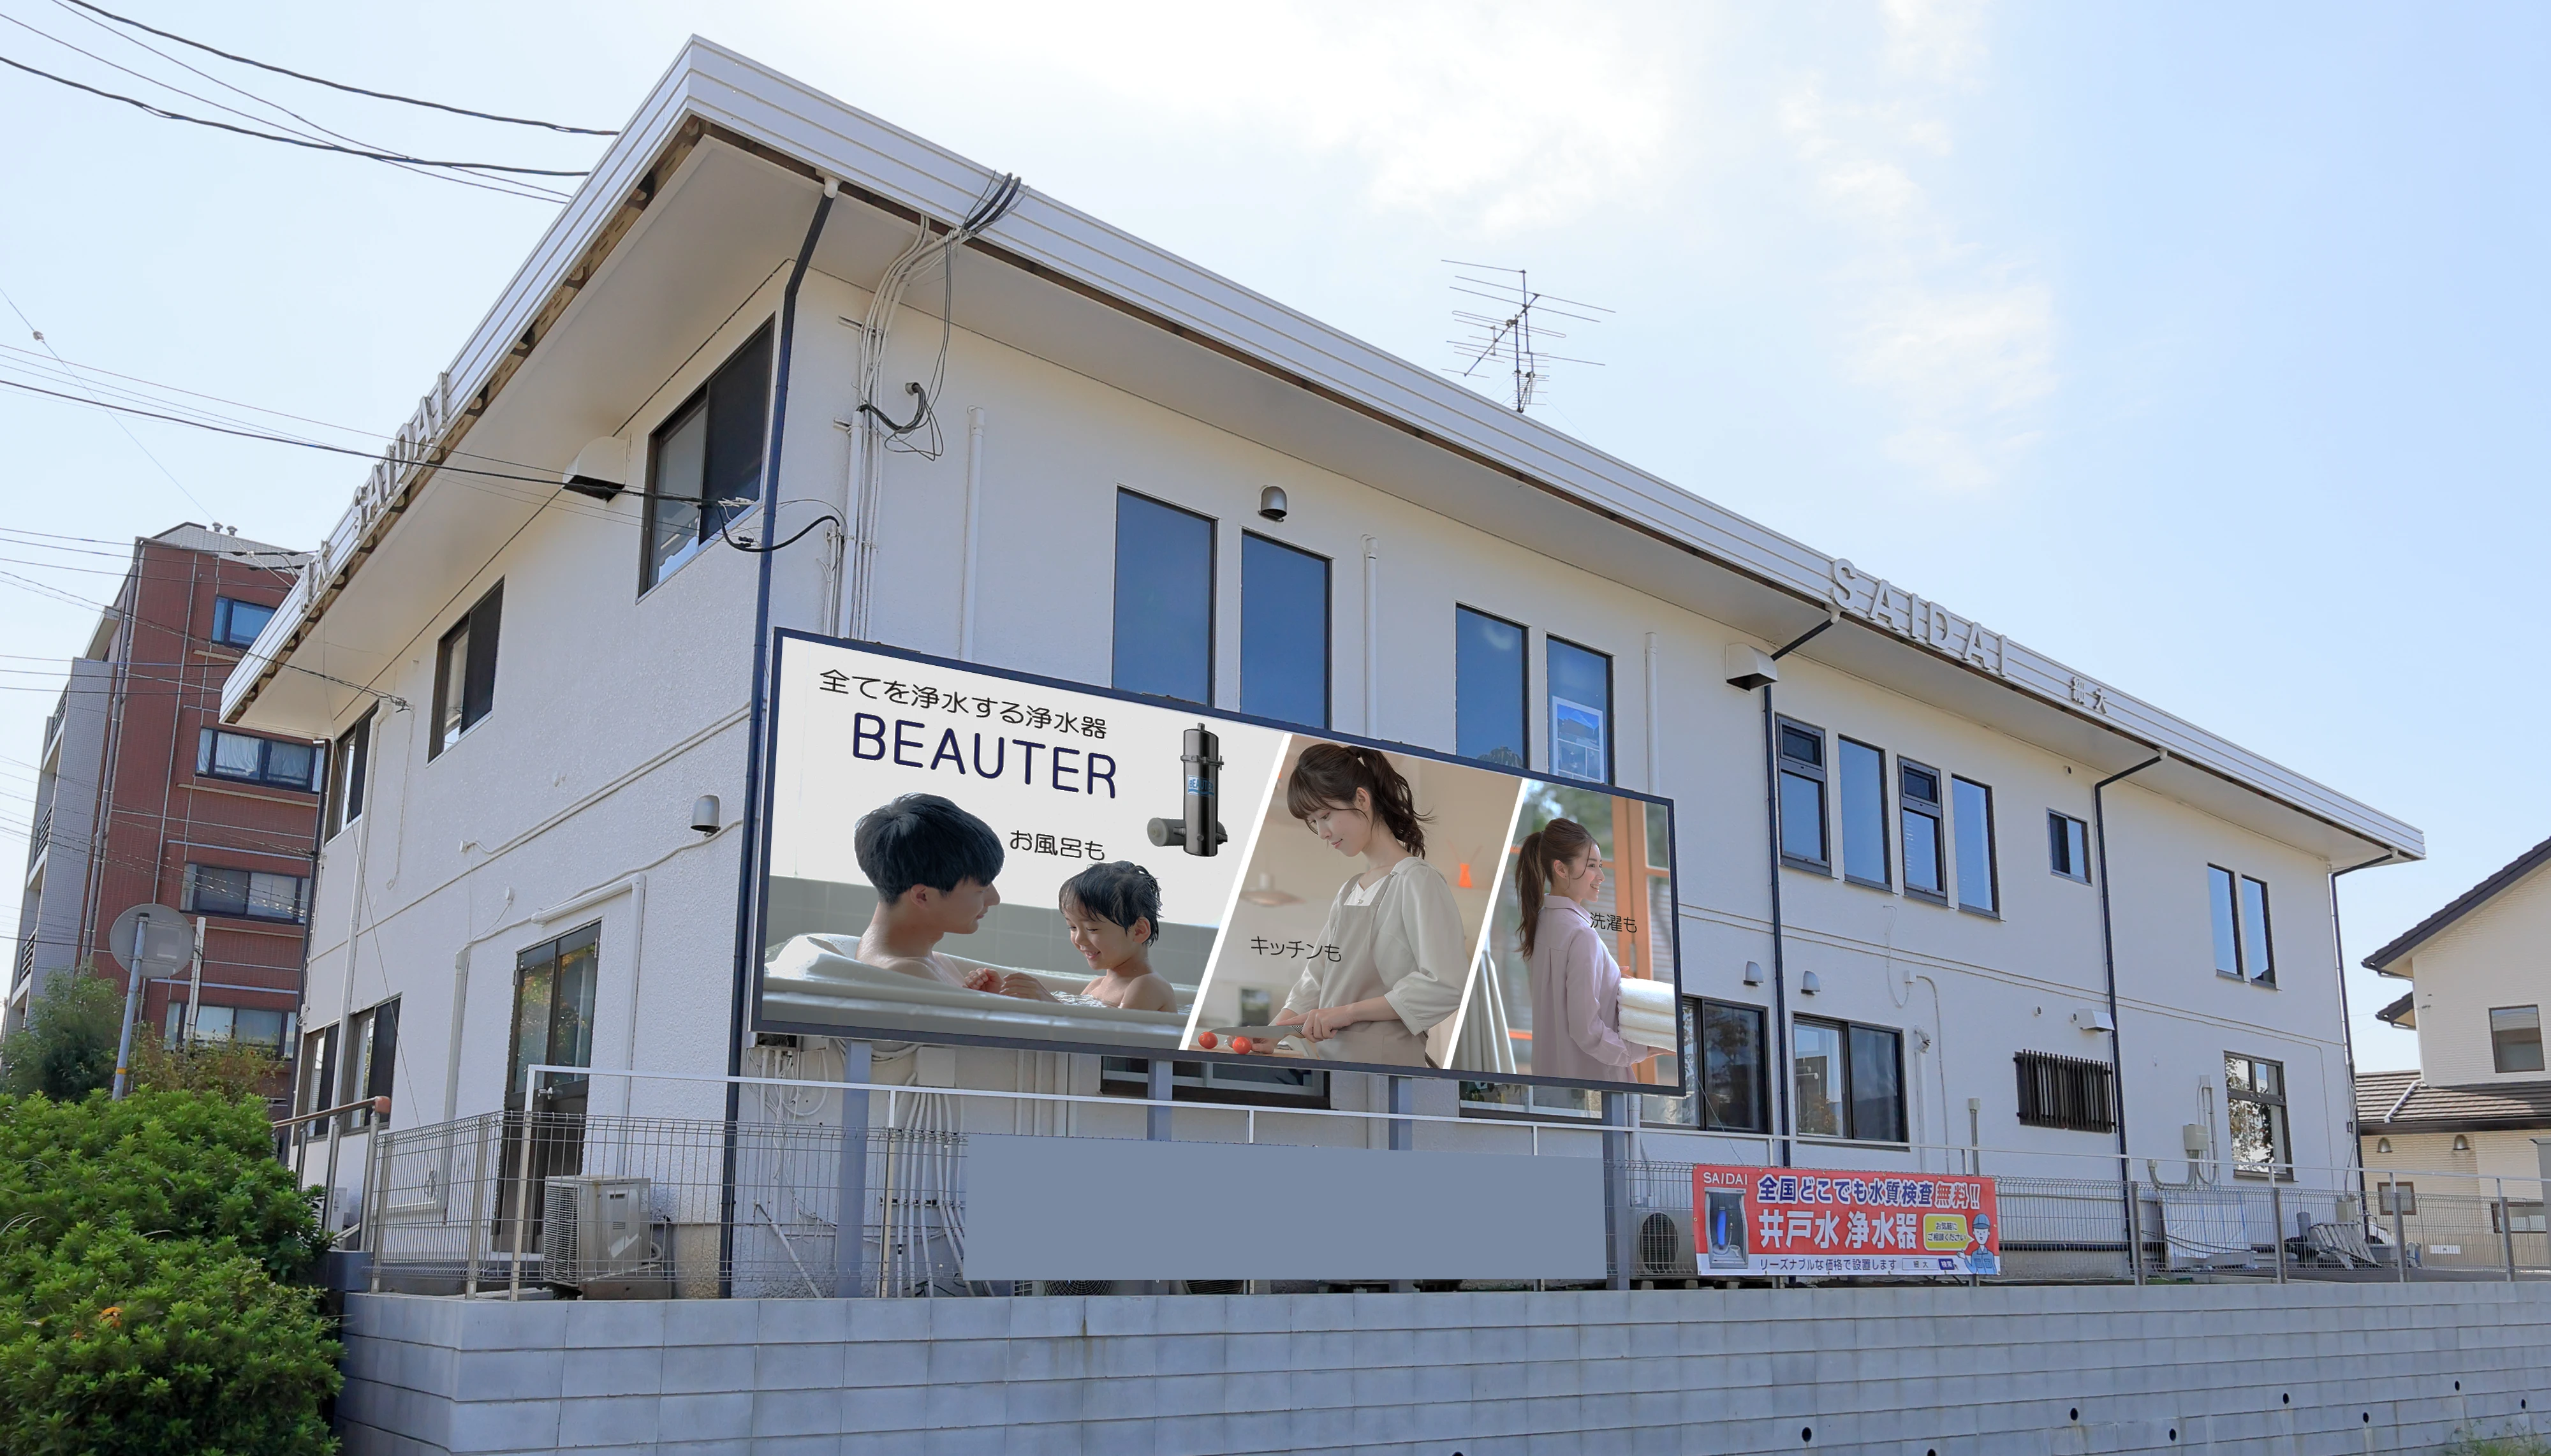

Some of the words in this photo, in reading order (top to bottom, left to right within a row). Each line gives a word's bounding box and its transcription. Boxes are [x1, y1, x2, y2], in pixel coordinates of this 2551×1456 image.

[351, 371, 448, 540] SAIDAI
[1830, 557, 2008, 677] SAIDAI
[818, 668, 1108, 740] 全てを浄水する浄水器
[851, 711, 1117, 800] BEAUTER
[1189, 778, 1214, 791] BEAUTER
[1009, 830, 1106, 862] お風呂も
[1589, 911, 1638, 934] 洗濯も
[1250, 936, 1342, 963] キッチンも
[1703, 1172, 1747, 1186] SAIDAI
[1927, 1232, 1967, 1242] ご相談ください
[1936, 1222, 1957, 1231] お気軽に
[1760, 1258, 1897, 1271] リーズナブルな価格で設置します
